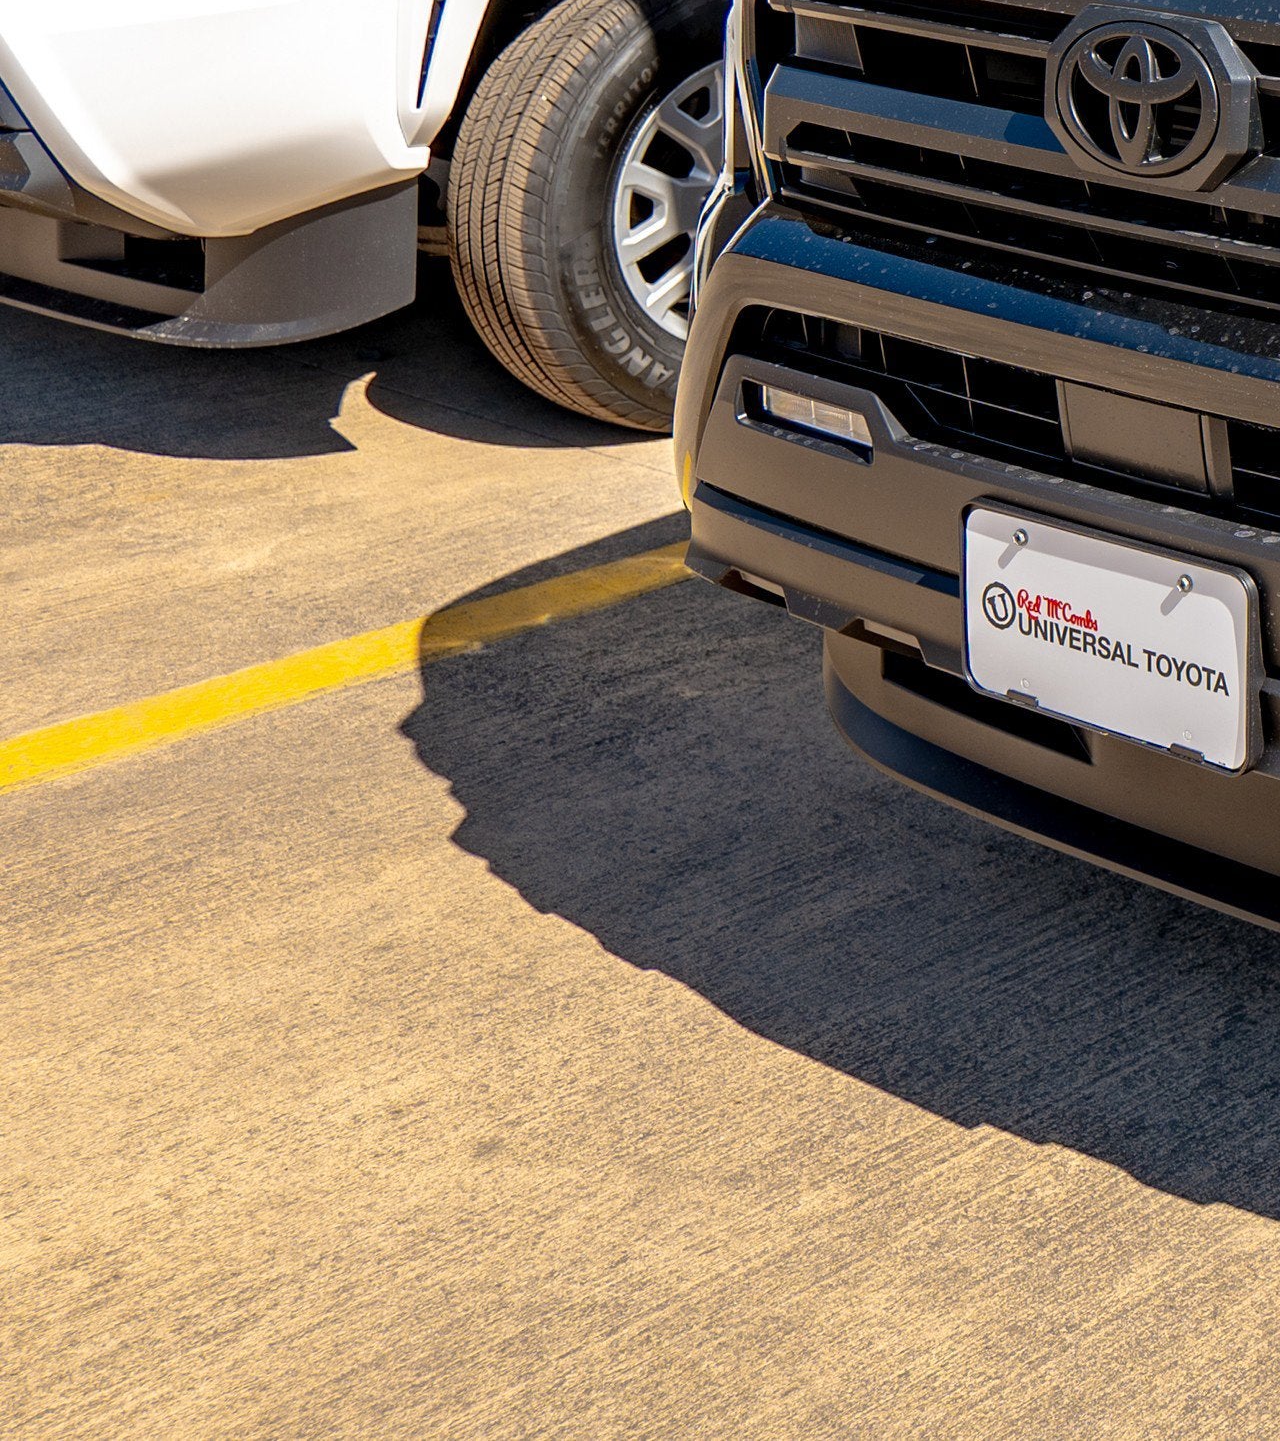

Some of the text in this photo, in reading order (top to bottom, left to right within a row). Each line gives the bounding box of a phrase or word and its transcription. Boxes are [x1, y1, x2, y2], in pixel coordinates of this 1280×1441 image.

[1016, 589, 1098, 632] Red McCombs
[1018, 612, 1230, 697] UNIVERSAL TOYOTA
